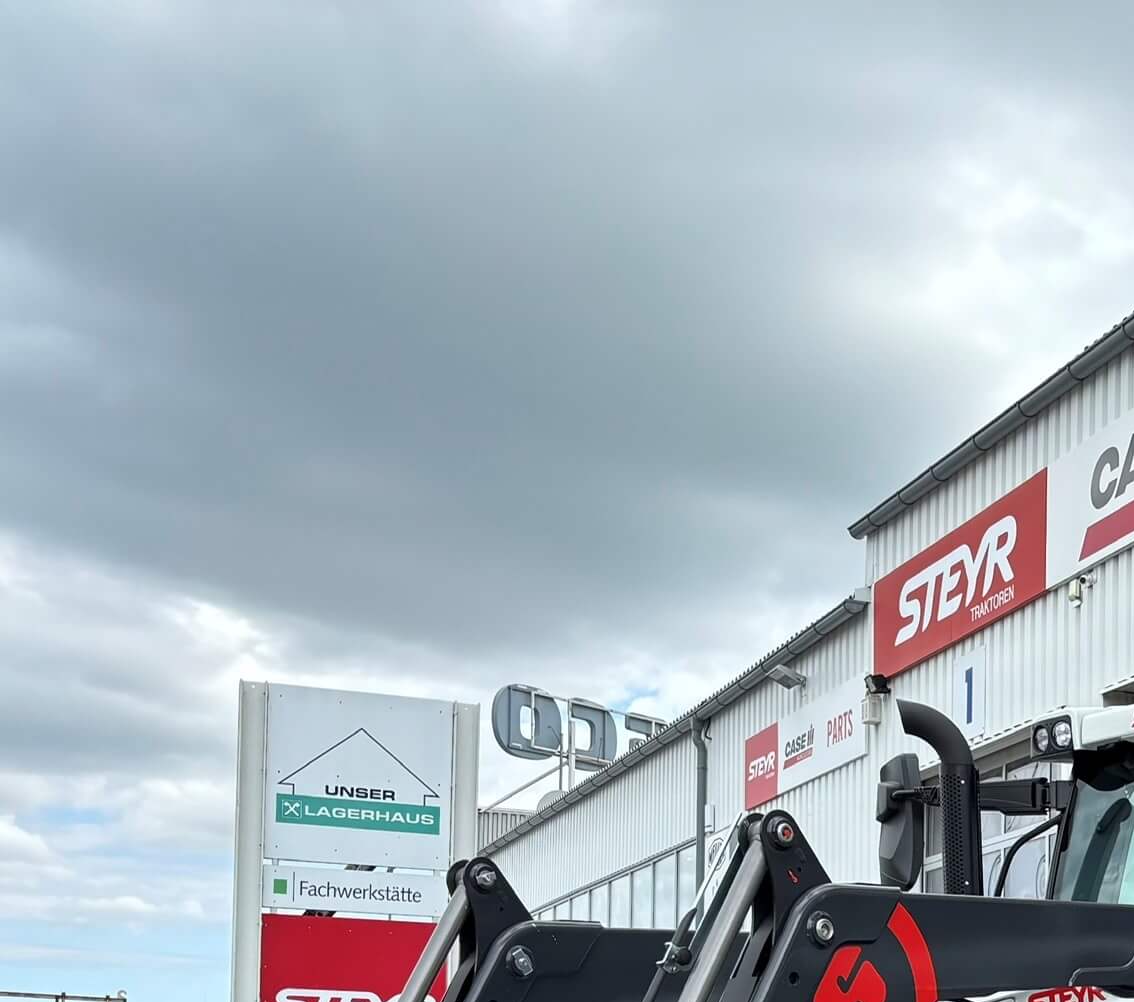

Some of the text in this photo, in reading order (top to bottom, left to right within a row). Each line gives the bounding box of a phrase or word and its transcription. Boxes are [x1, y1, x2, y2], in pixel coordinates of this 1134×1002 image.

[894, 515, 1017, 647] STEYR
[970, 584, 1015, 622] TRAKTOREN
[964, 667, 973, 724] 1
[827, 709, 853, 747] PARTS
[785, 732, 807, 757] CASE
[748, 751, 776, 781] STEYR
[325, 784, 395, 801] UNSER
[305, 806, 434, 825] LAGERHAUS
[300, 880, 422, 903] Fachwerkstätte
